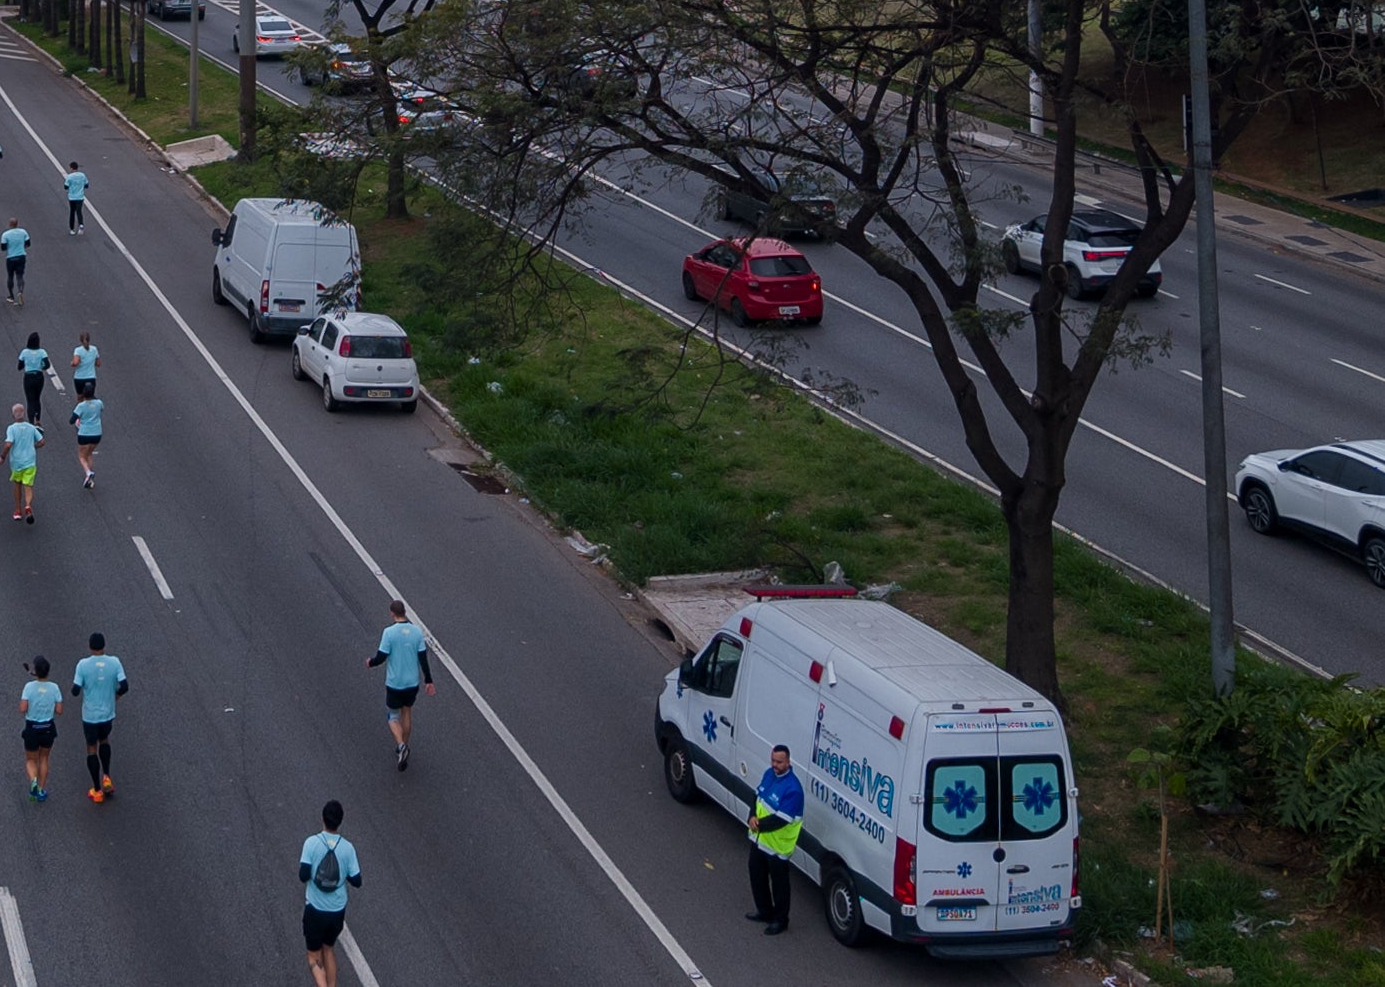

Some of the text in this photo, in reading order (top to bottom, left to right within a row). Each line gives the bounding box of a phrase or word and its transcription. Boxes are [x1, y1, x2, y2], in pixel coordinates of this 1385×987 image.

[810, 778, 829, 803] (11)
[830, 793, 886, 845] 3604-2400
[932, 887, 985, 896] AMBULÂNCIA
